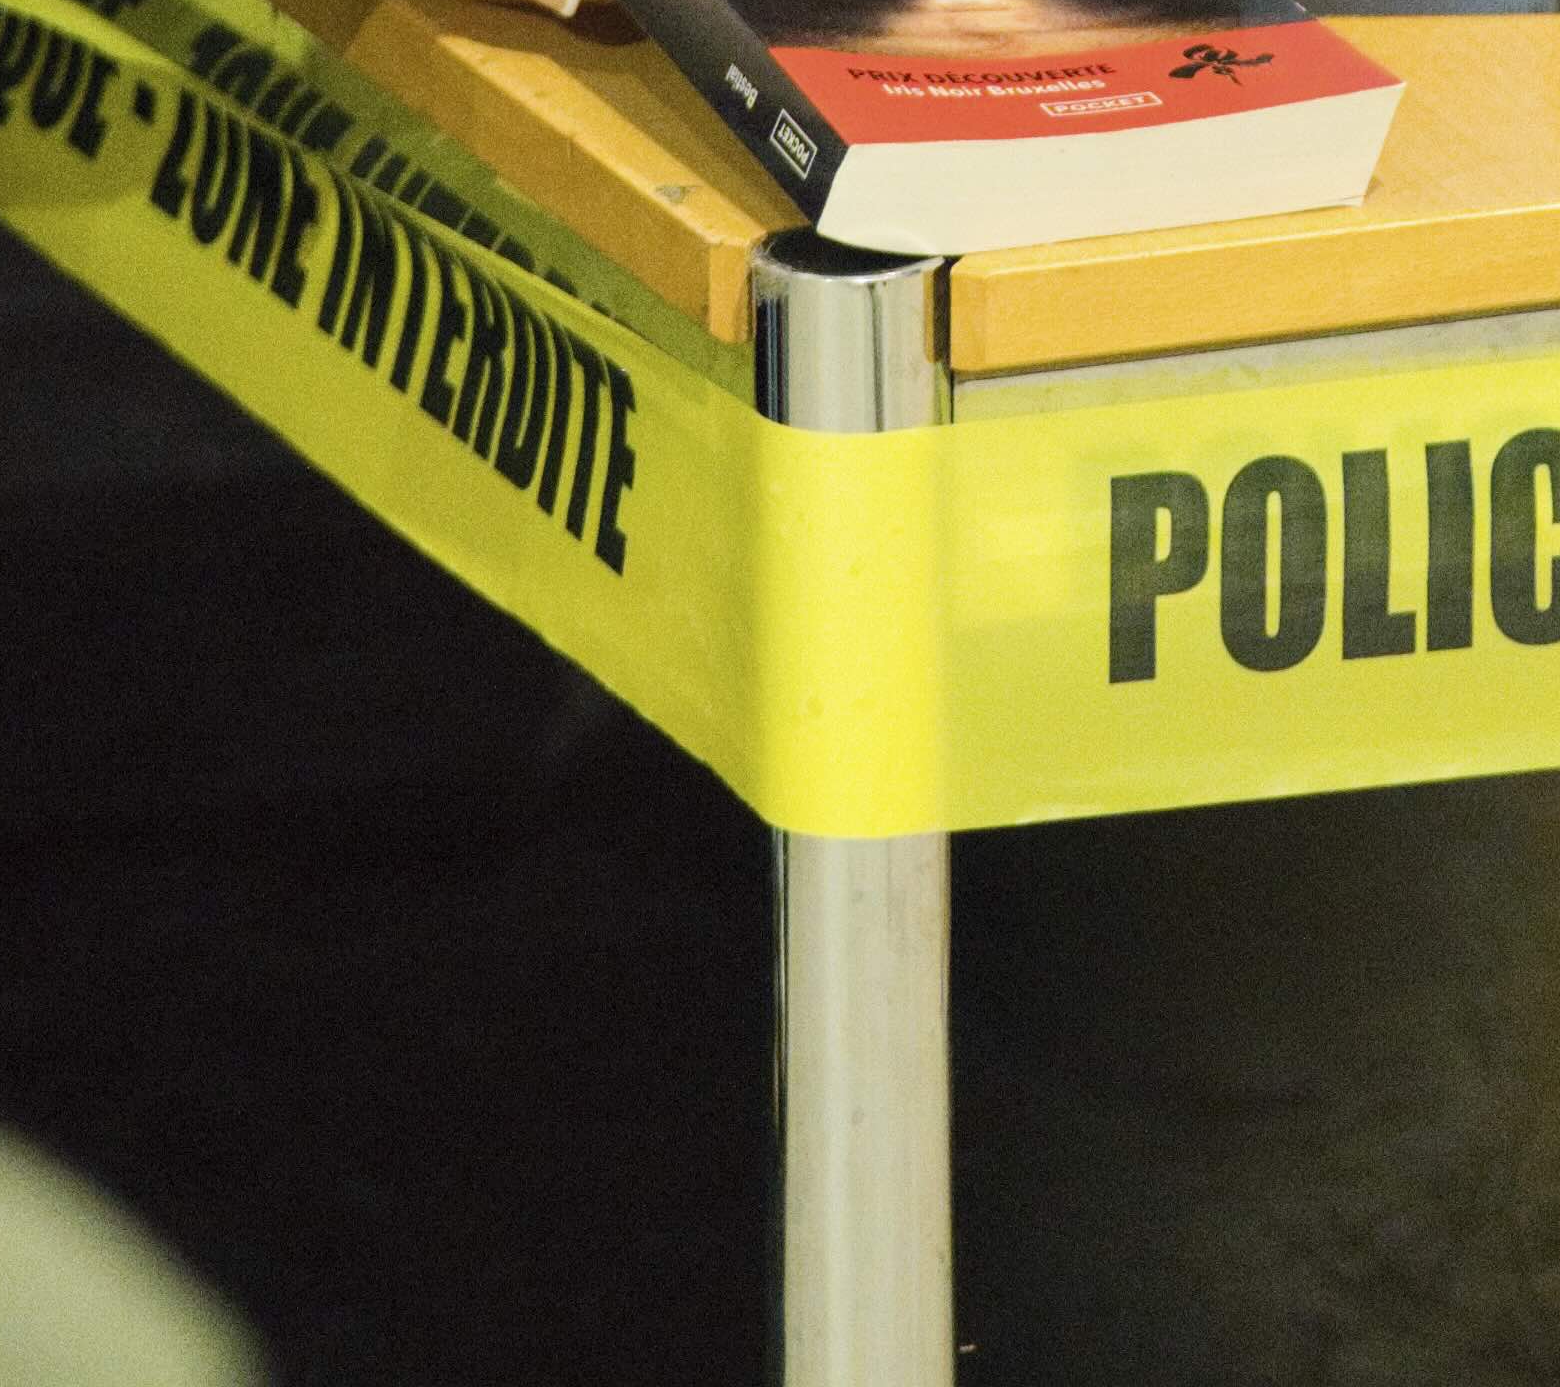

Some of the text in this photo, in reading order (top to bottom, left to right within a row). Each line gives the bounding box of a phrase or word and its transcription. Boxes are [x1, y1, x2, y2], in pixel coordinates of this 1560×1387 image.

[725, 63, 759, 110] Bestial
[847, 66, 919, 84] PRIX
[882, 78, 1107, 99] Iris Noir Bruxelles
[1054, 96, 1146, 113] POCKET
[777, 126, 811, 166] POCKET
[149, 88, 321, 311] ZONE
[318, 165, 637, 576] INTERDITE
